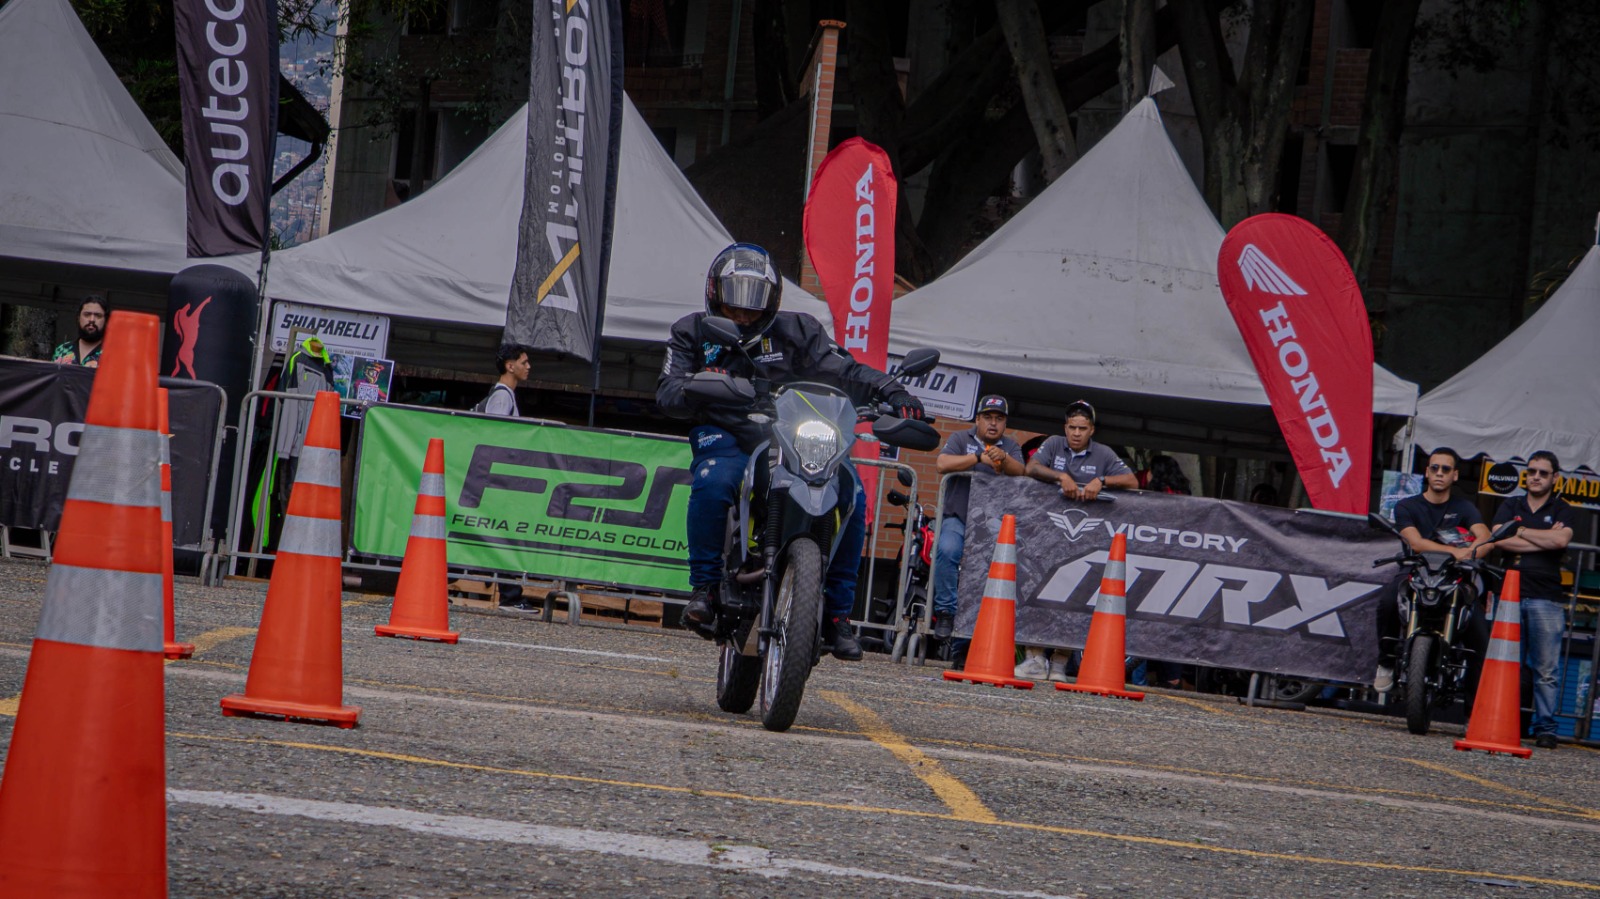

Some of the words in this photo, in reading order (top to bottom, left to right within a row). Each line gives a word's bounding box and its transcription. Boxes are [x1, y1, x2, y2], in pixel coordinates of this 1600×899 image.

[845, 163, 875, 353] HONDA
[281, 313, 379, 340] SHIAPARELLI
[1259, 301, 1352, 489] HONDA
[0, 456, 59, 475] CLE
[1488, 474, 1518, 482] MALVINAS
[452, 514, 509, 532] FERIA
[515, 521, 530, 534] 2
[534, 523, 616, 544] RUEDAS
[1104, 520, 1248, 553] VICTORY
